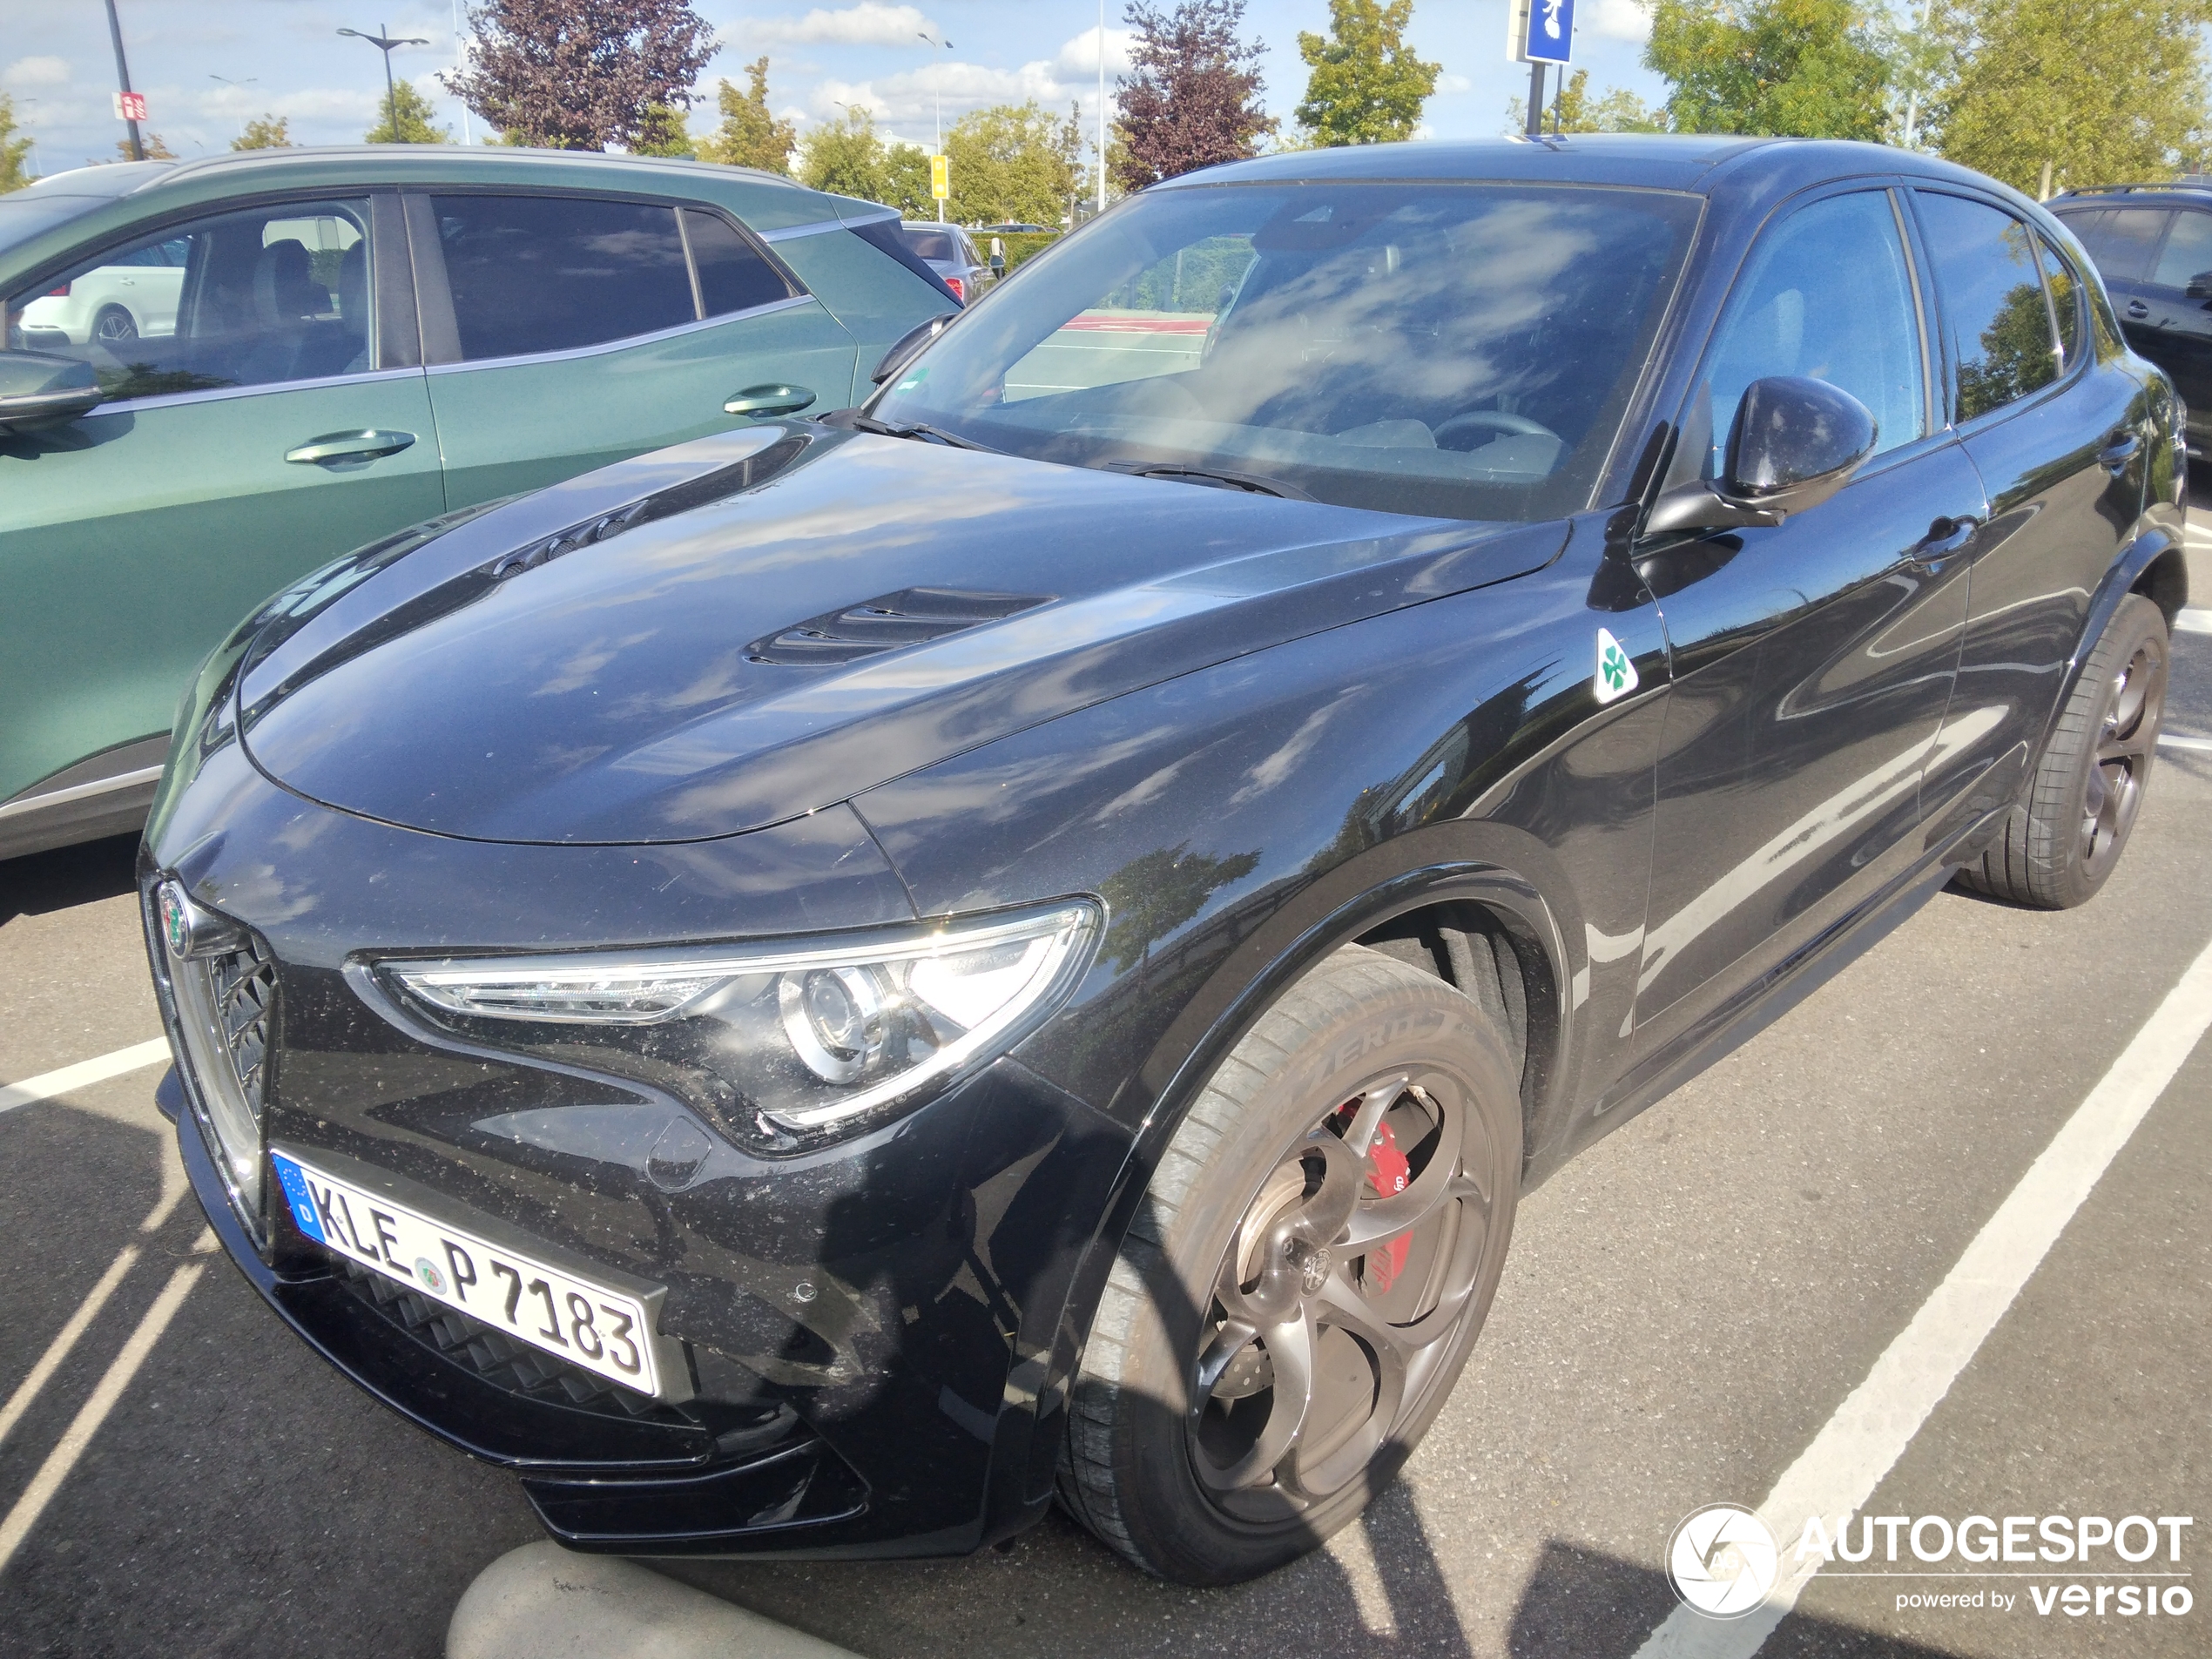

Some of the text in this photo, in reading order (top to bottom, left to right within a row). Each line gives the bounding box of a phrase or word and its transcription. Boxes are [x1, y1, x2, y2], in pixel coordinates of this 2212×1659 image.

[299, 1204, 313, 1223] D
[307, 1178, 642, 1376] KLE P 7183
